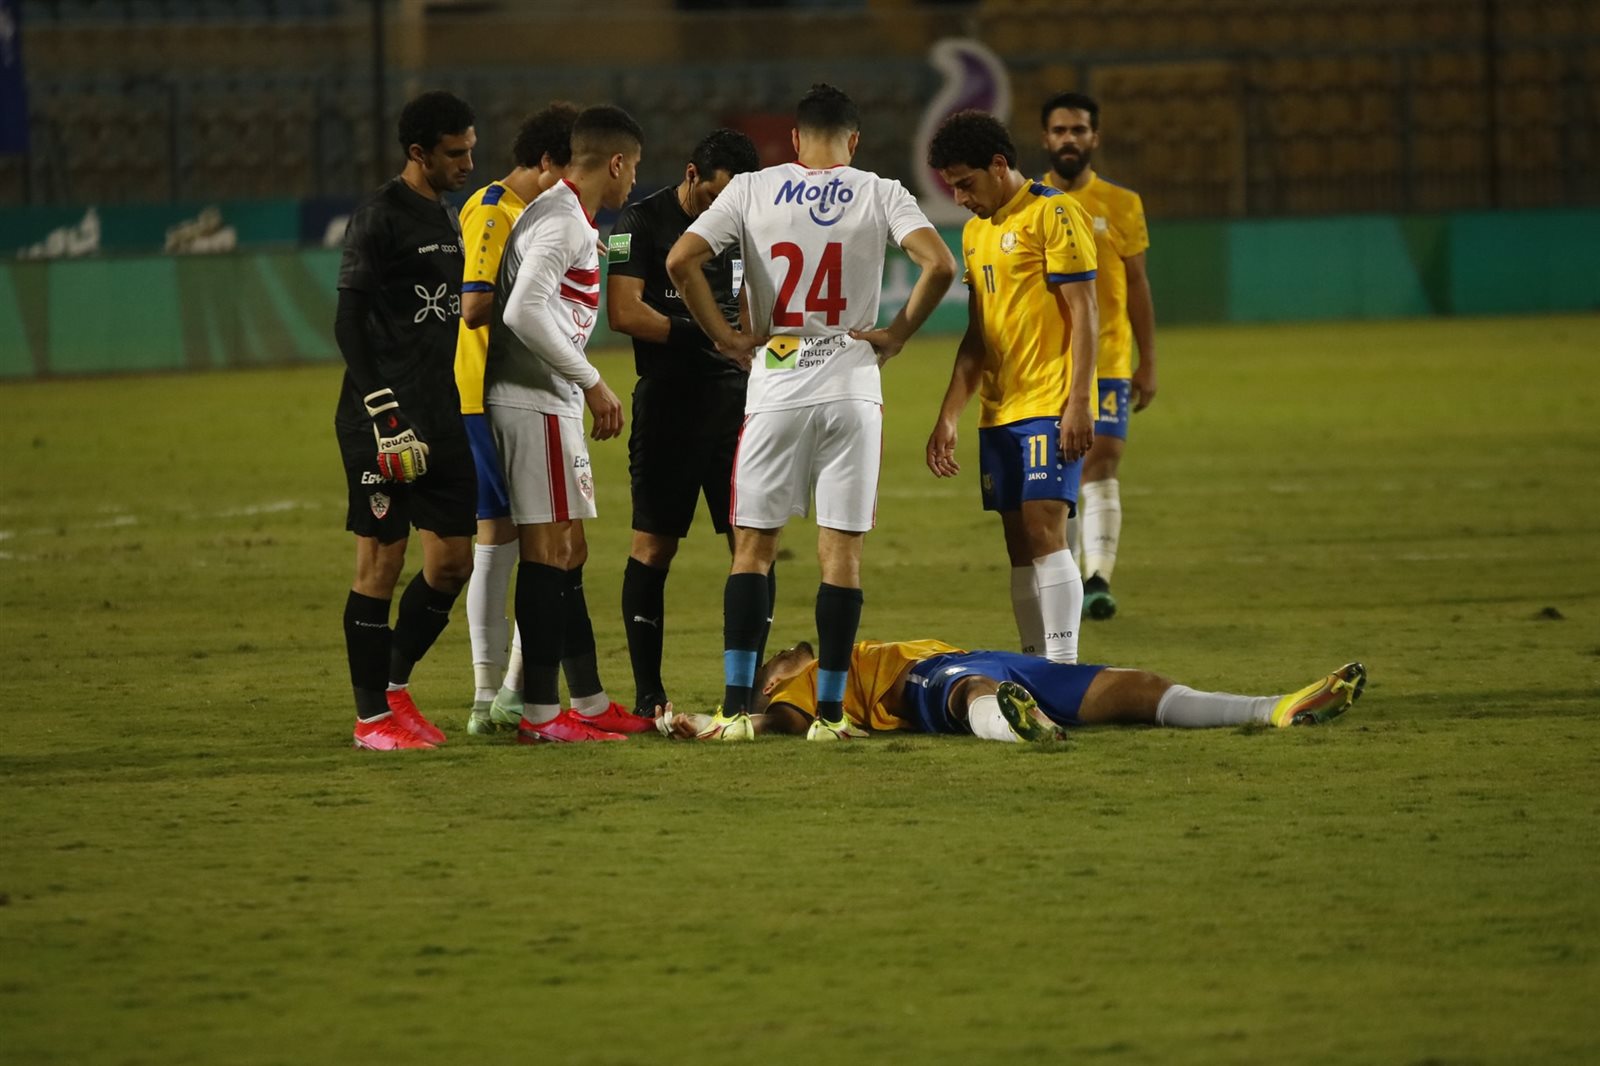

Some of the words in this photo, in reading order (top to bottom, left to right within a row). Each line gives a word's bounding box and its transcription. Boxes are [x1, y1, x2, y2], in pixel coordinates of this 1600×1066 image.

[771, 241, 848, 328] 24
[983, 264, 996, 294] 11
[1101, 390, 1118, 416] 4
[381, 433, 416, 451] reusch
[1028, 434, 1048, 468] 11
[1028, 472, 1048, 481] JAKO
[1047, 631, 1073, 640] JAKO
